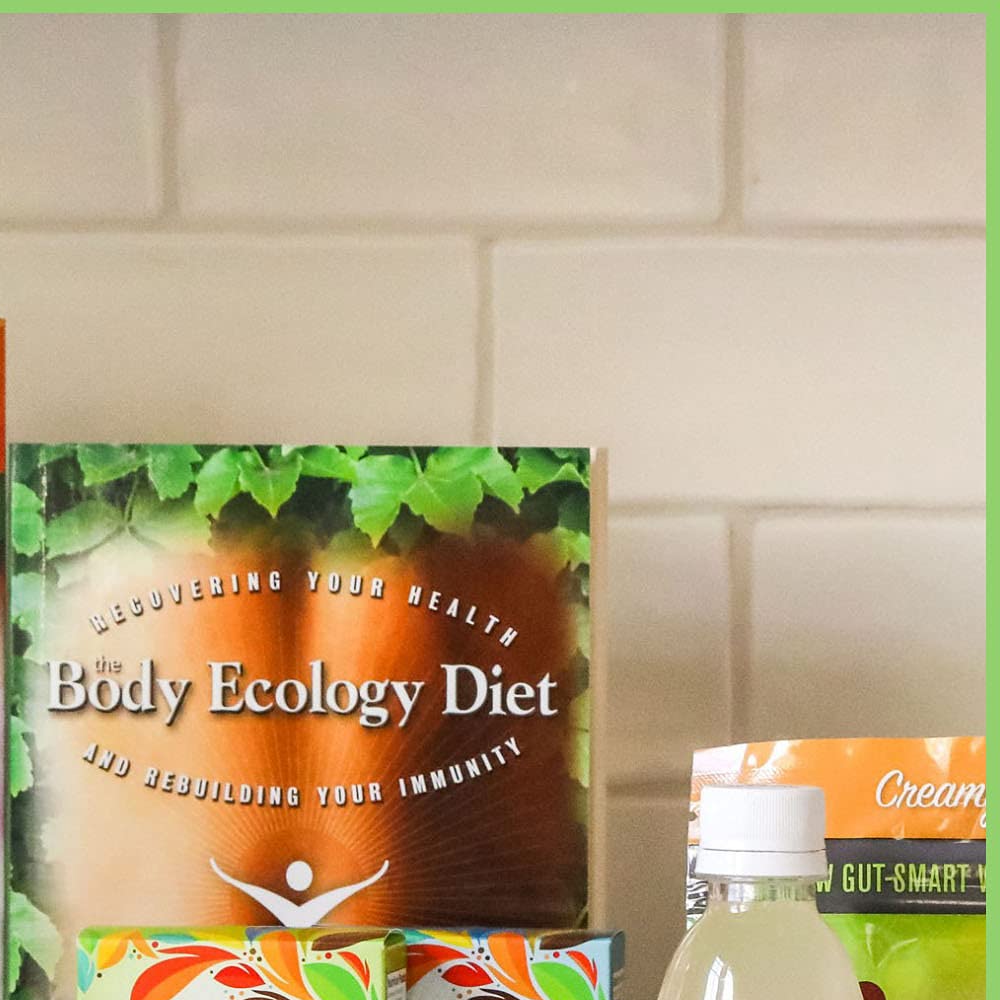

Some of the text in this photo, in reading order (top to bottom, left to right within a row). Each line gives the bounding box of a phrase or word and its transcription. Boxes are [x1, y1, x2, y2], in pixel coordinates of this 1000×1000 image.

[89, 570, 520, 647] RECOVERING YOUR HEALTH
[46, 658, 559, 728] Body Ecology Diet
[94, 654, 121, 673] the
[82, 736, 524, 807] AND REBUILDING YOUR IMMUNITY
[842, 862, 968, 894] GUT-SMART
